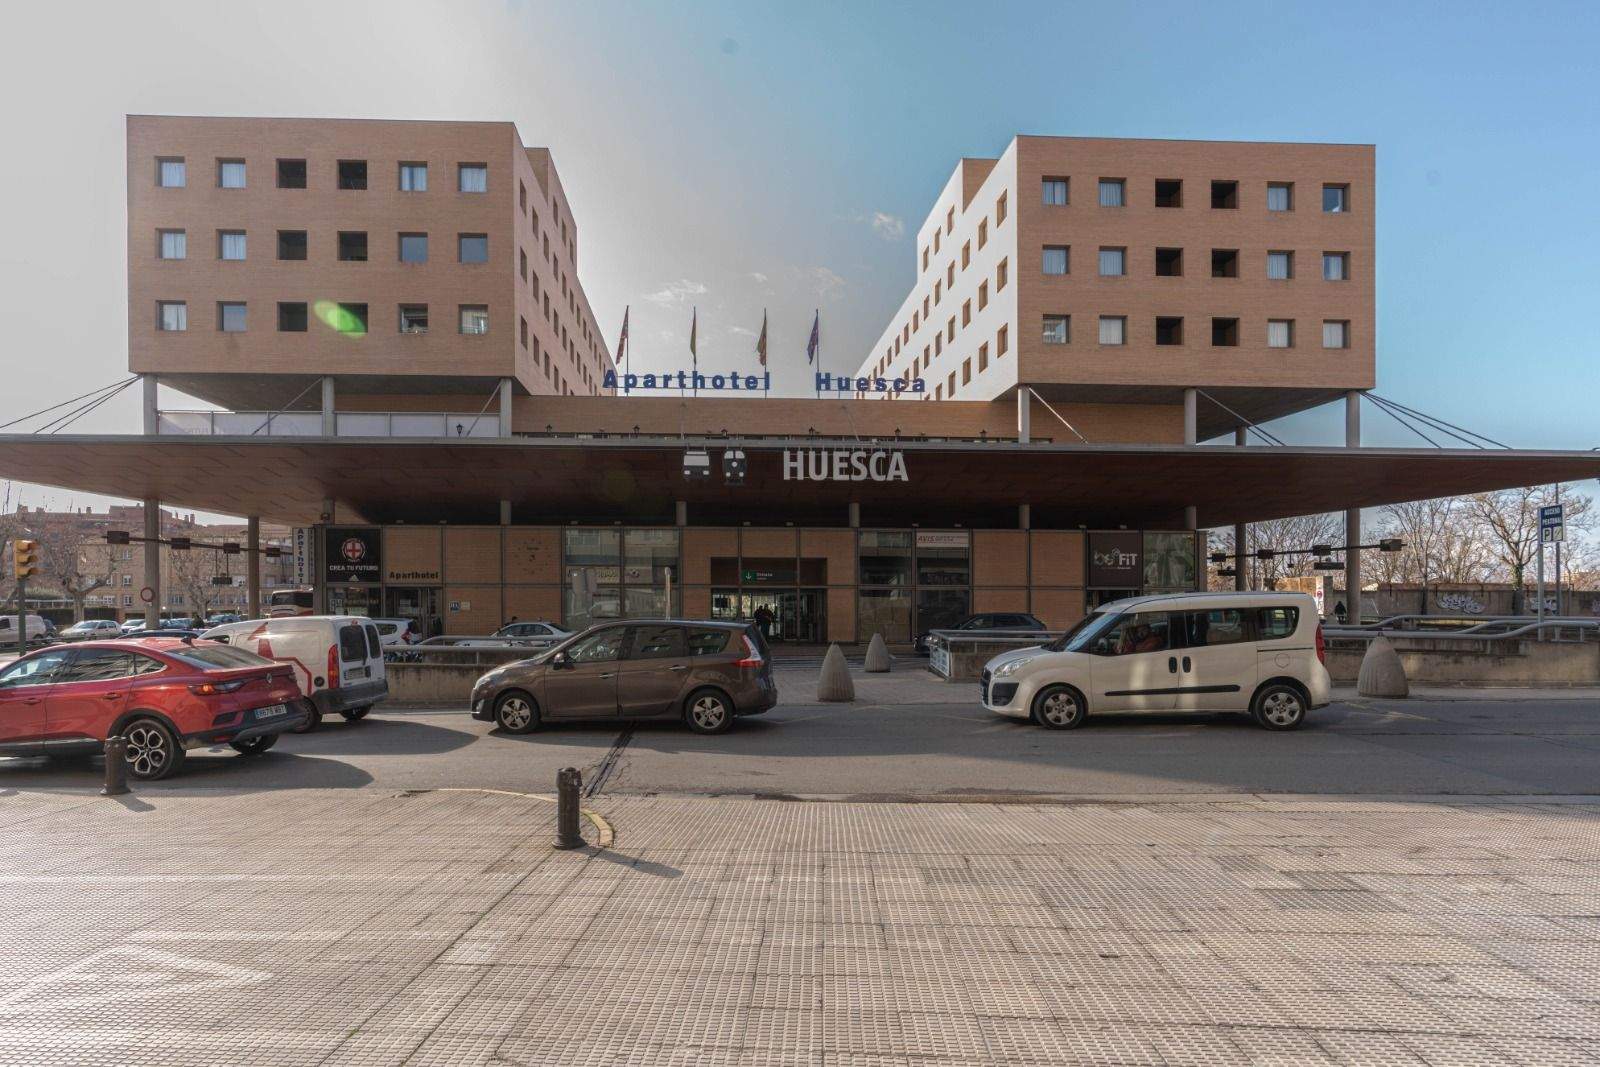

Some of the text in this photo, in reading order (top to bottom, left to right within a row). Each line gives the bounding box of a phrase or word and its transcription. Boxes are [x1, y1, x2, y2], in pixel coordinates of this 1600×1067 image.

[602, 369, 925, 393] Aparthotel Huesca
[783, 450, 909, 481] HUESCA
[1544, 529, 1551, 540] P
[389, 571, 439, 580] Aparthotel
